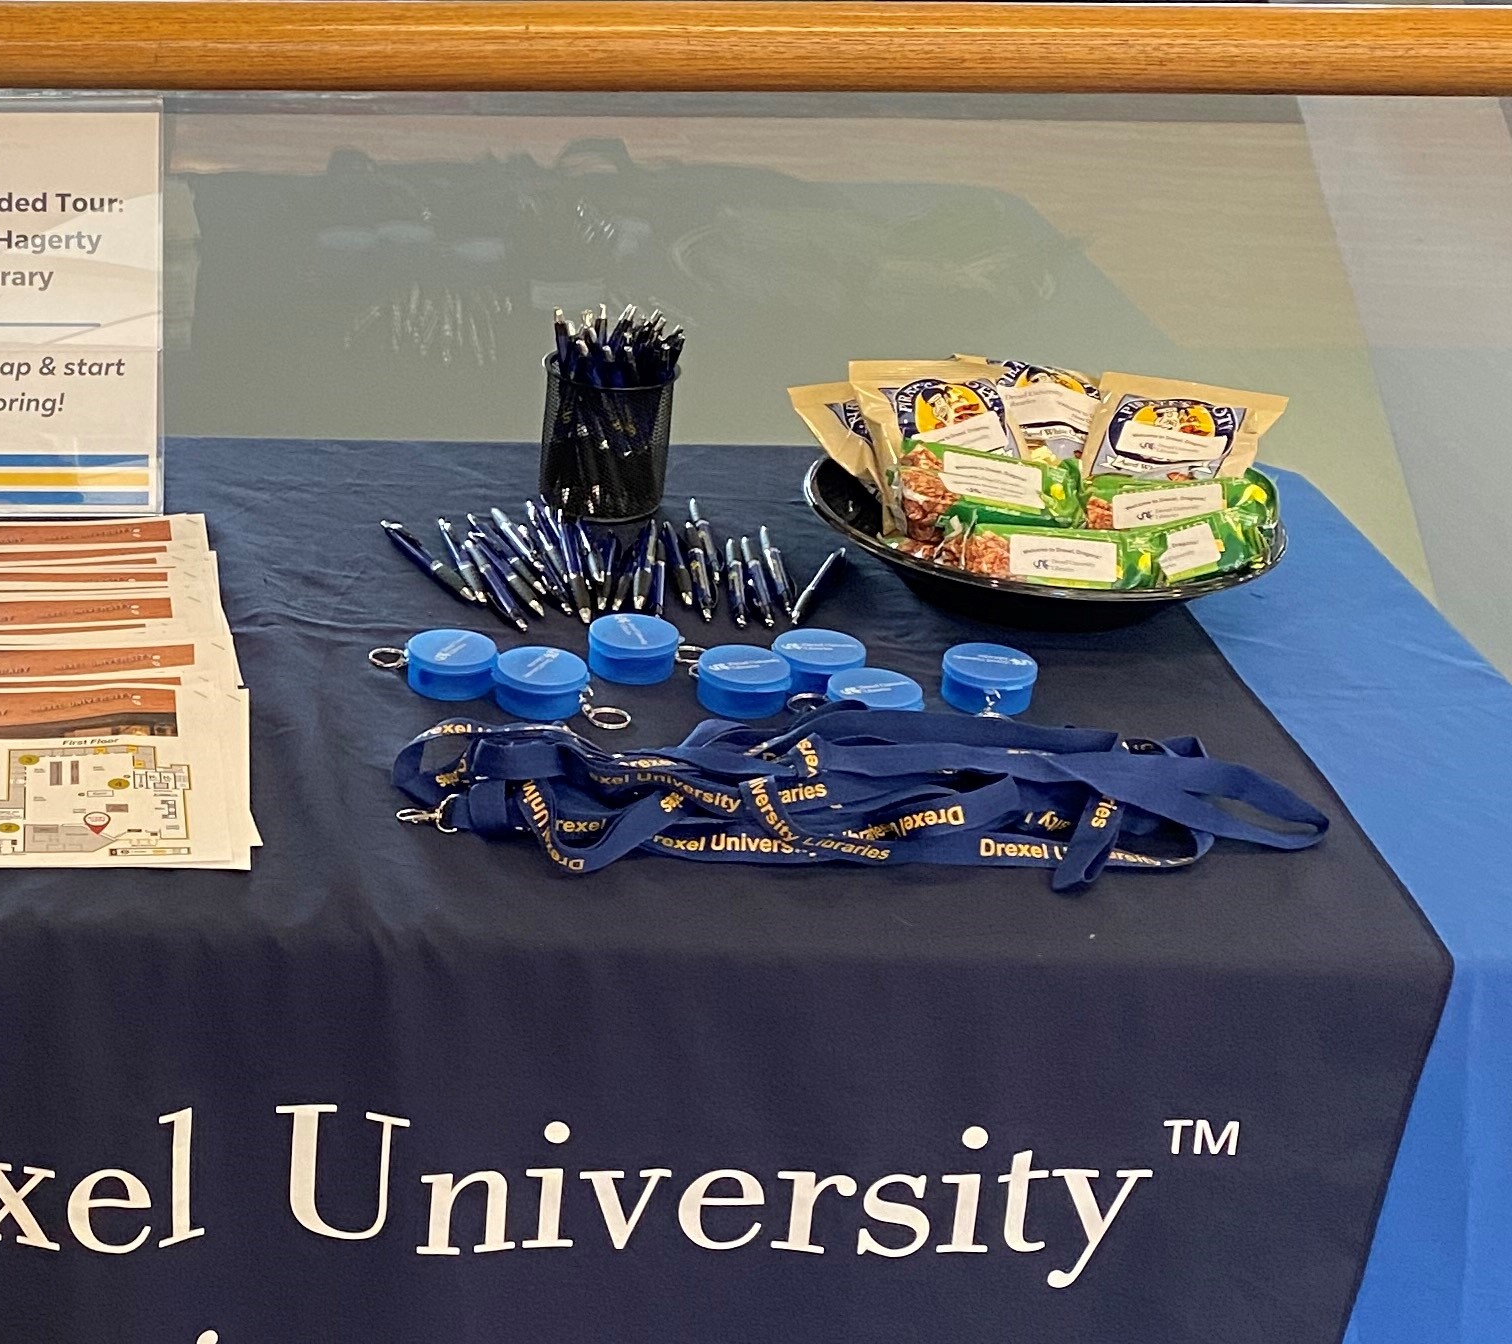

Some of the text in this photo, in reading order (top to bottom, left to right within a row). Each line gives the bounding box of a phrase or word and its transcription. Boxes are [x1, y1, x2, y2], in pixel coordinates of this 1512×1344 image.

[55, 193, 124, 212] Tour:
[39, 356, 56, 376] &
[63, 359, 125, 376] start
[90, 737, 119, 745] Floor
[636, 772, 742, 812] University
[556, 818, 607, 832] rexel
[980, 837, 1049, 859] Drexel
[274, 1102, 1155, 1290] University
